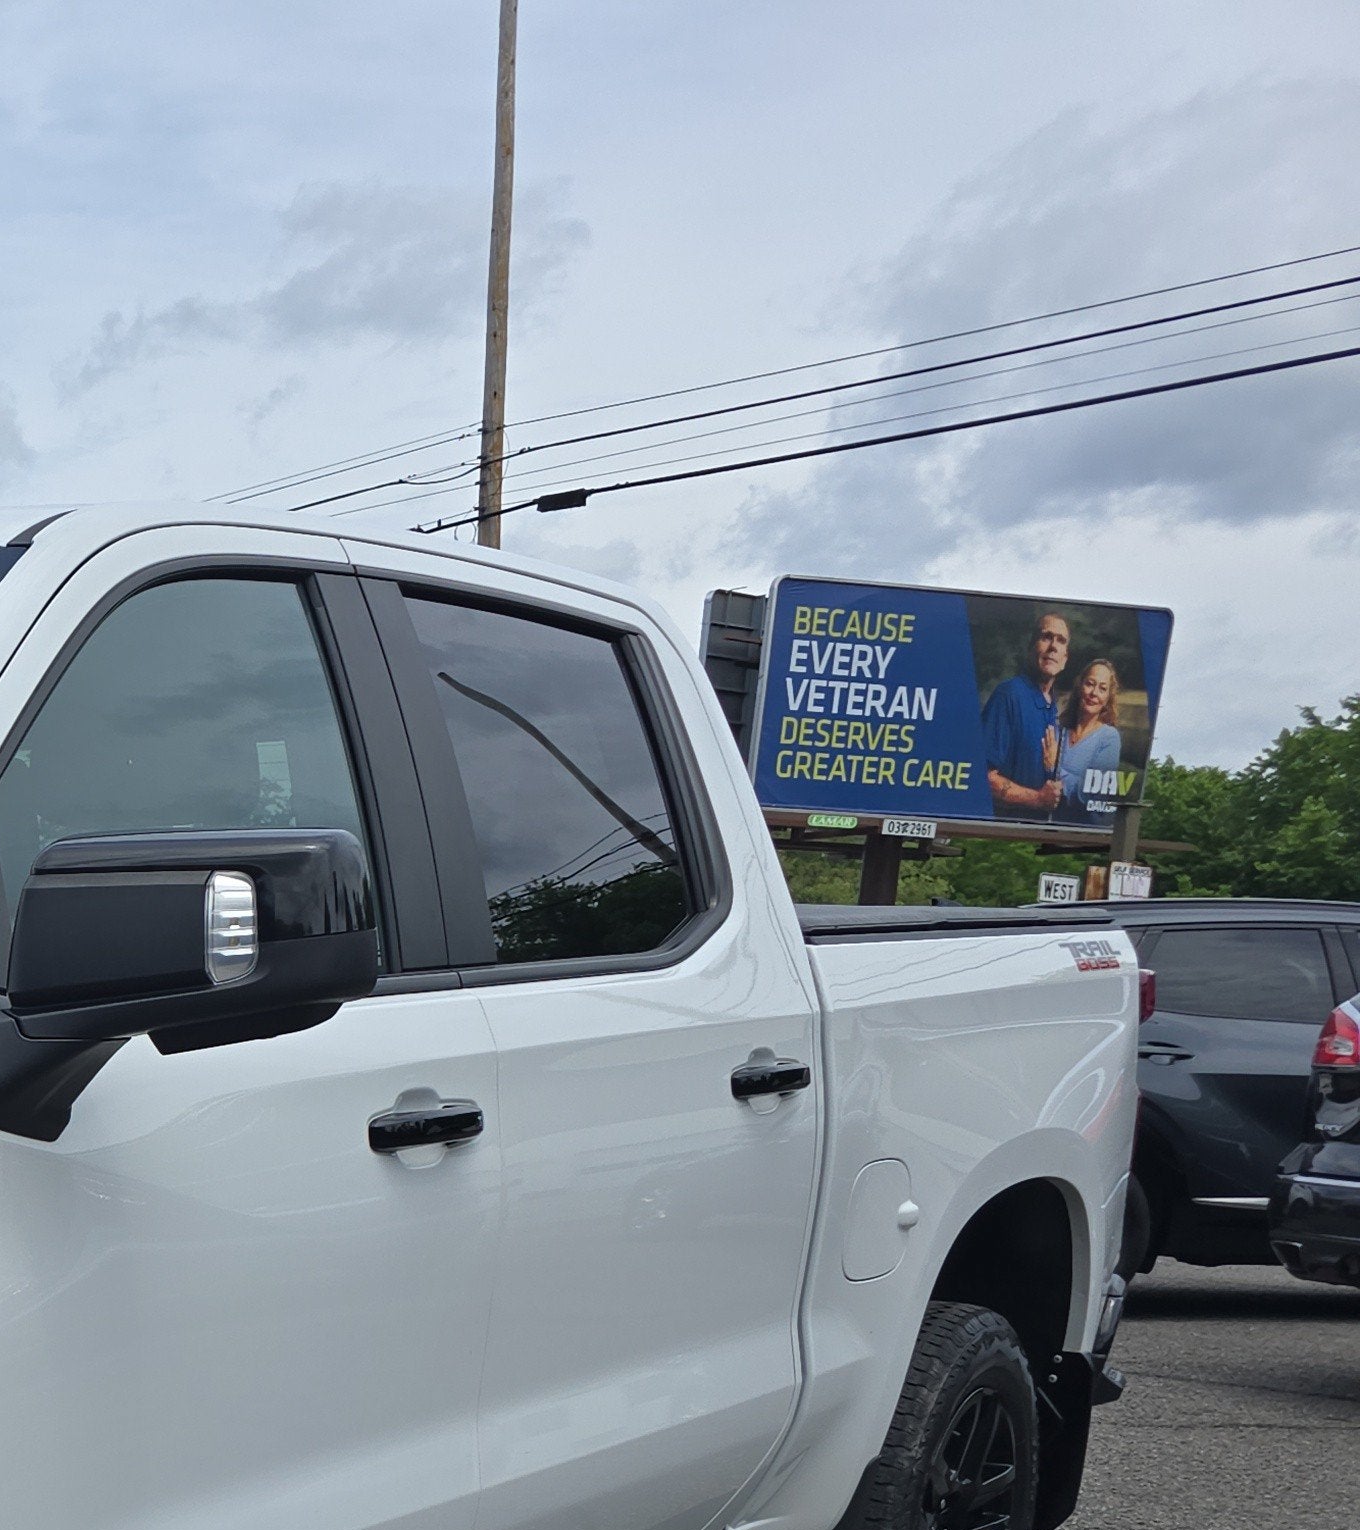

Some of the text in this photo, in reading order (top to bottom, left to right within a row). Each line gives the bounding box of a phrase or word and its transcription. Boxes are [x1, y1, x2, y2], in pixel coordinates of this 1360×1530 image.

[793, 606, 916, 643] BECAUSE
[789, 639, 896, 679] EVERY
[785, 677, 938, 721] VETERAN
[780, 716, 916, 753] DESERVES
[776, 750, 972, 790] GREATER CARE
[1082, 768, 1137, 796] DAV
[1045, 880, 1074, 900] WEST
[1058, 940, 1122, 959] TRAIL
[1075, 956, 1121, 972] BOSS
